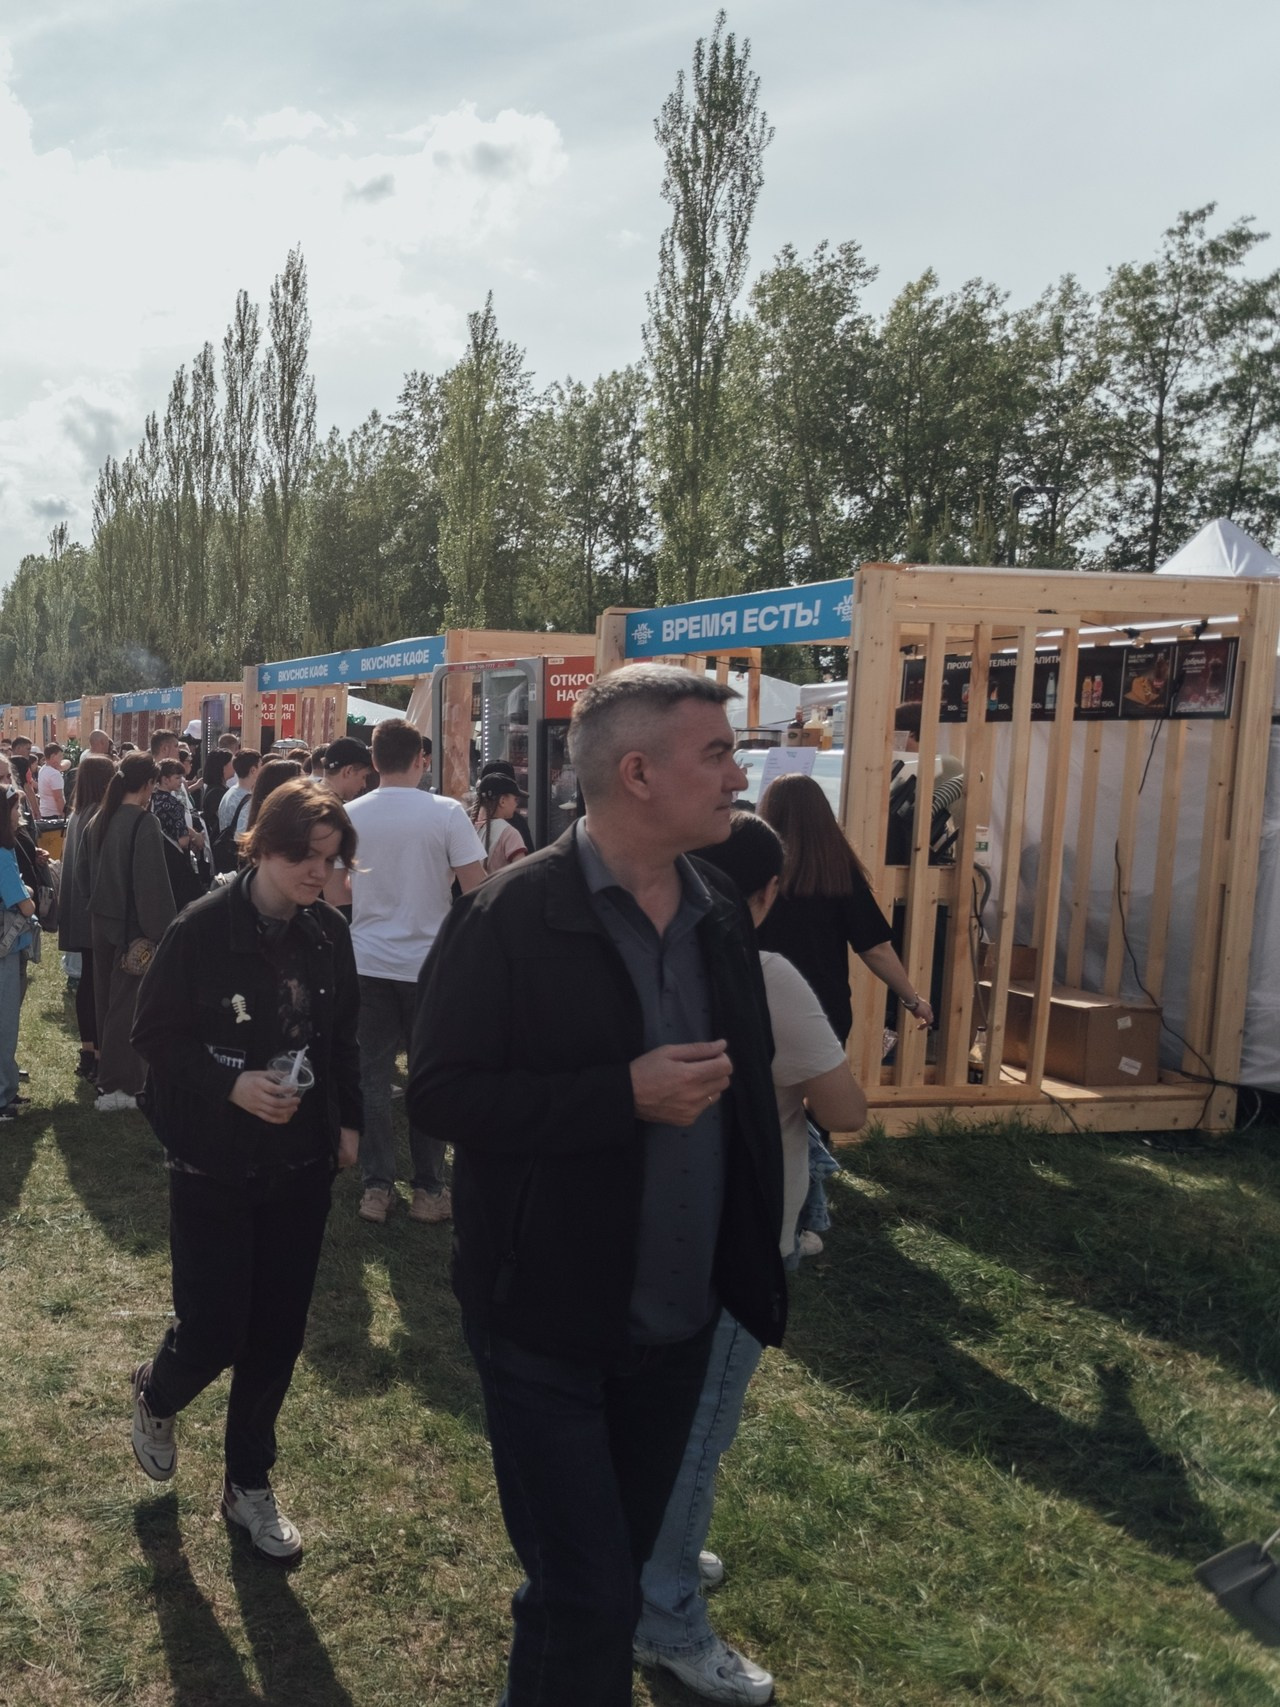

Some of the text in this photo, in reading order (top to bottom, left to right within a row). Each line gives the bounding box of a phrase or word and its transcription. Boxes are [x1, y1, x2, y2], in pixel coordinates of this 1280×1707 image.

[637, 622, 649, 631] VK
[662, 599, 822, 643] ВРЕМЯ ЕСТЬ!
[631, 628, 654, 641] fest
[360, 653, 402, 672] ВКУСНОЕ
[402, 649, 430, 667] КАФЕ
[277, 666, 308, 682] ВКУСНОЕ
[309, 664, 329, 679] КАФЕ
[550, 673, 596, 687] ОТКРО
